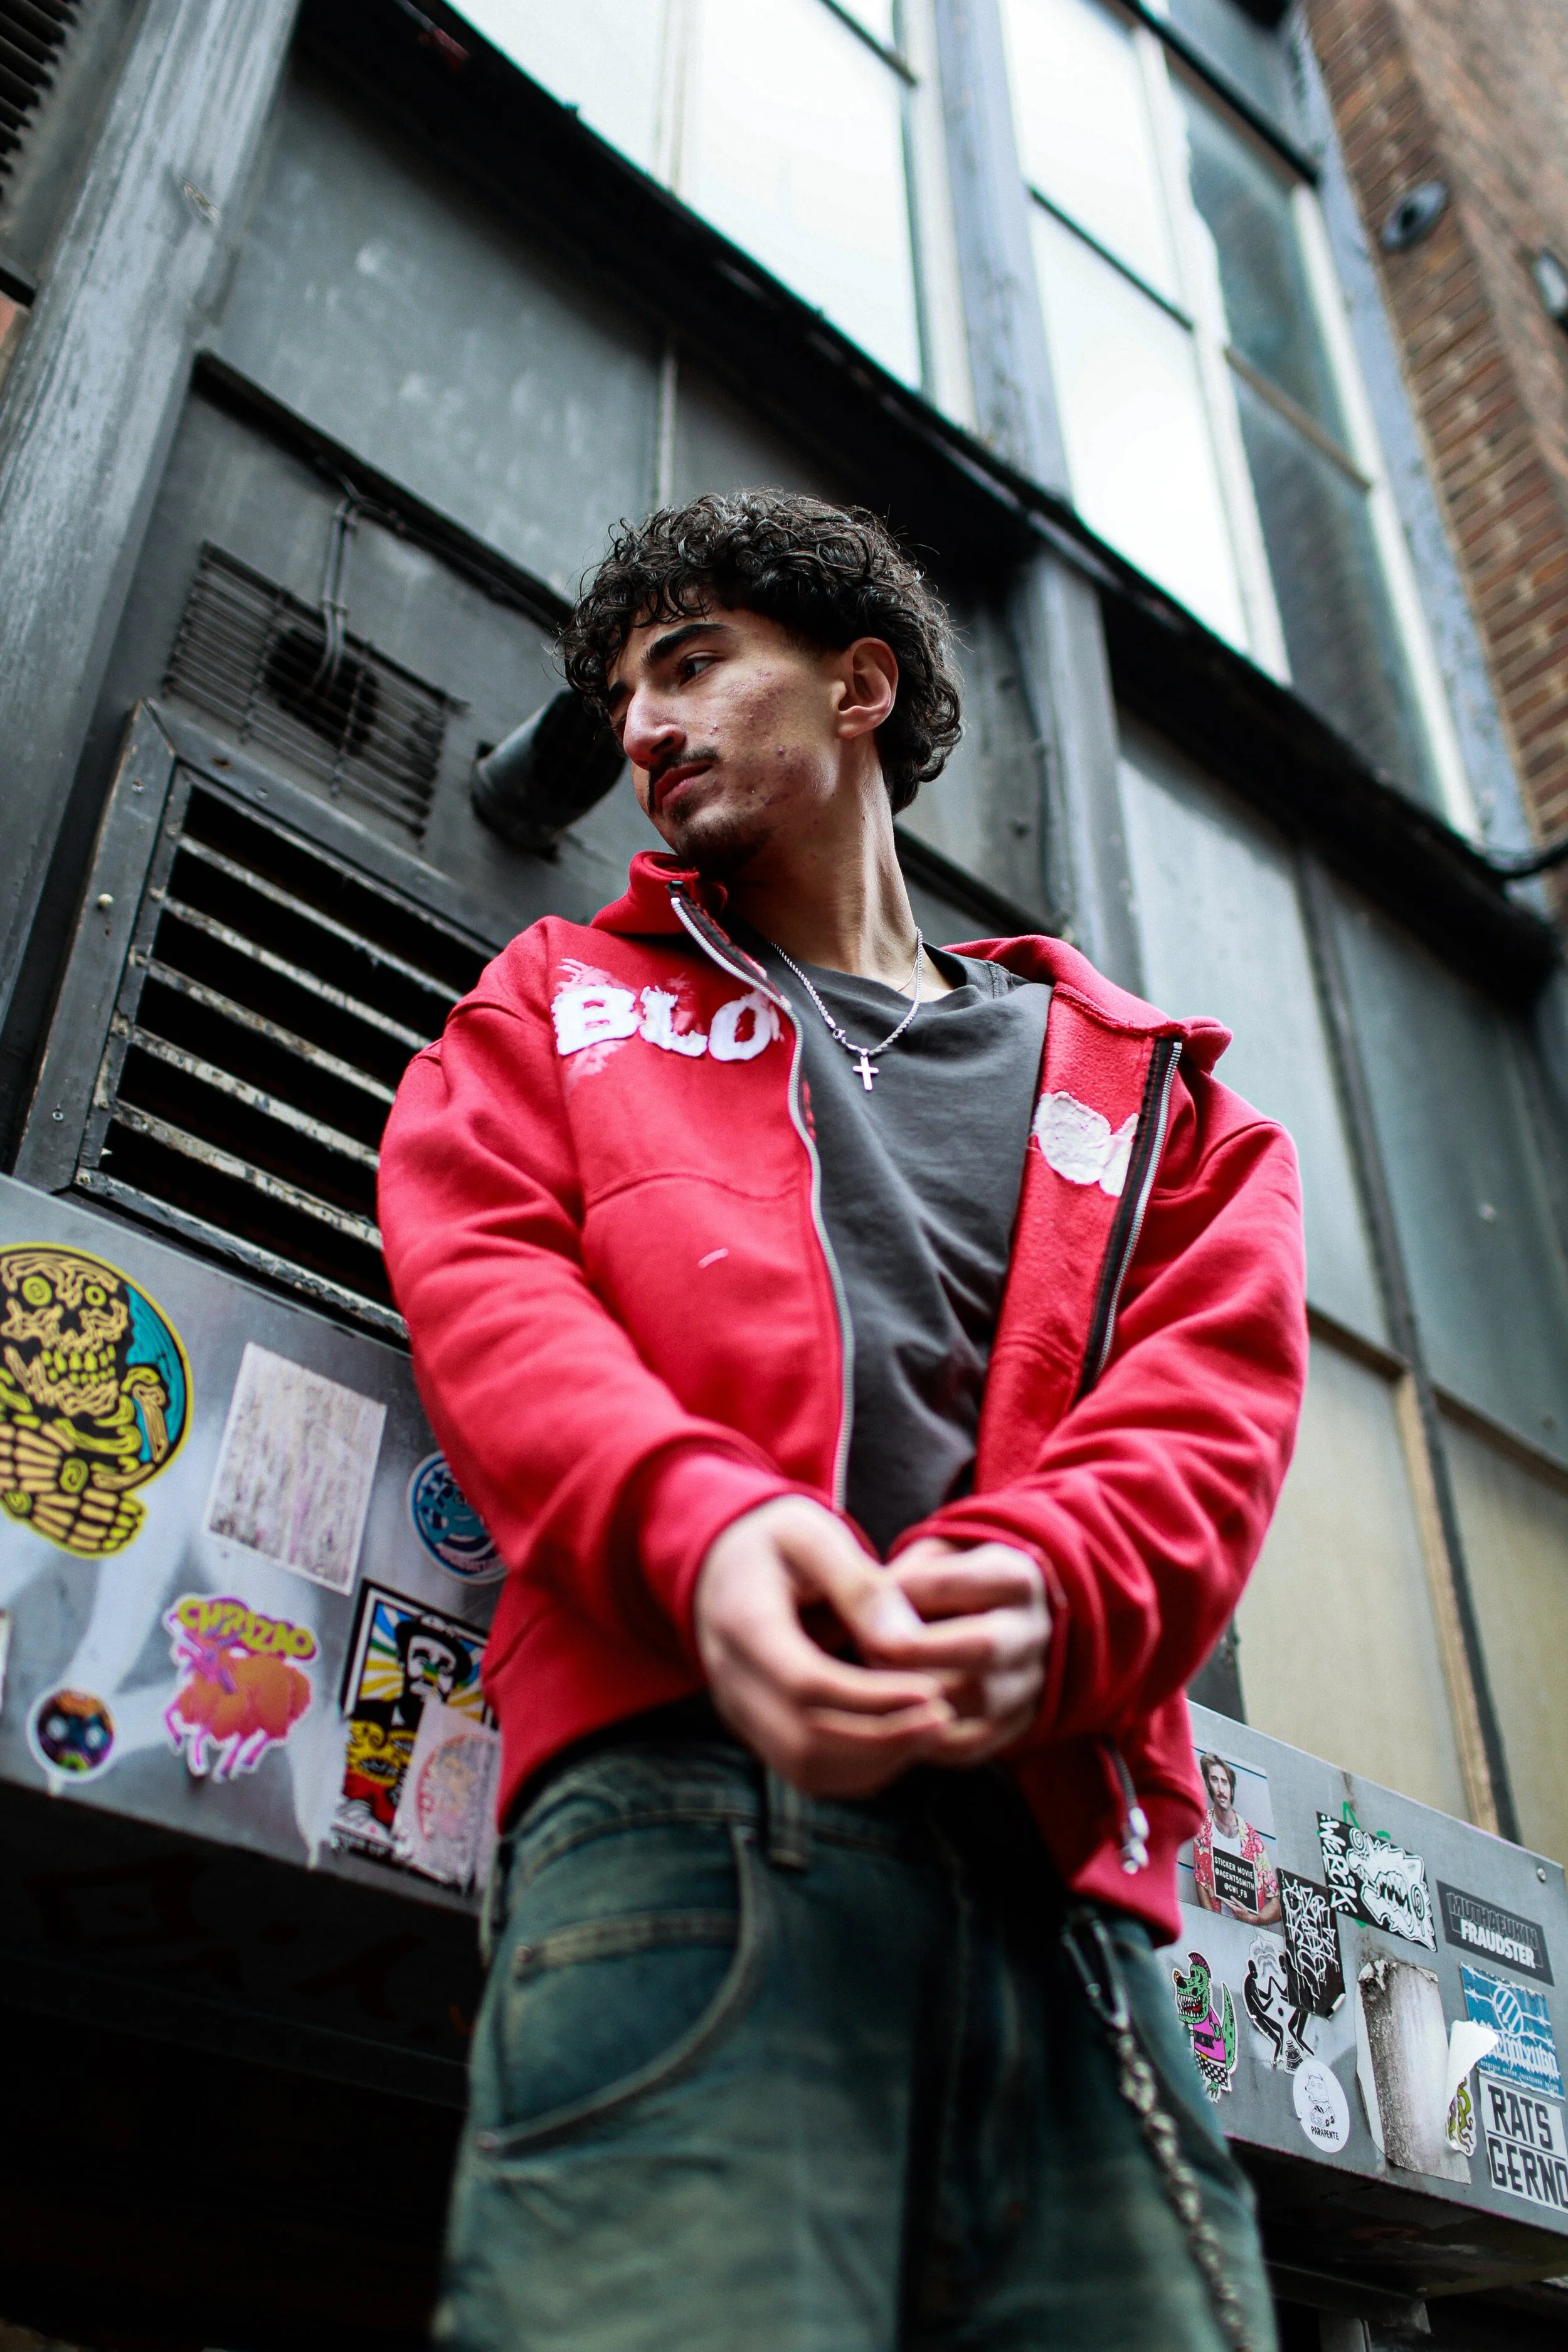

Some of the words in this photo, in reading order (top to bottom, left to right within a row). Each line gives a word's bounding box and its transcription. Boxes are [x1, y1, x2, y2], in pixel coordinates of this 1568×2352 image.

[1214, 1856, 1236, 1872] STICKER
[1237, 1866, 1254, 1880] MOVIE
[1460, 1918, 1536, 1969] FRAUDSTER
[1311, 2126, 1340, 2141] PARAPENTE
[1488, 2084, 1553, 2151] RATS
